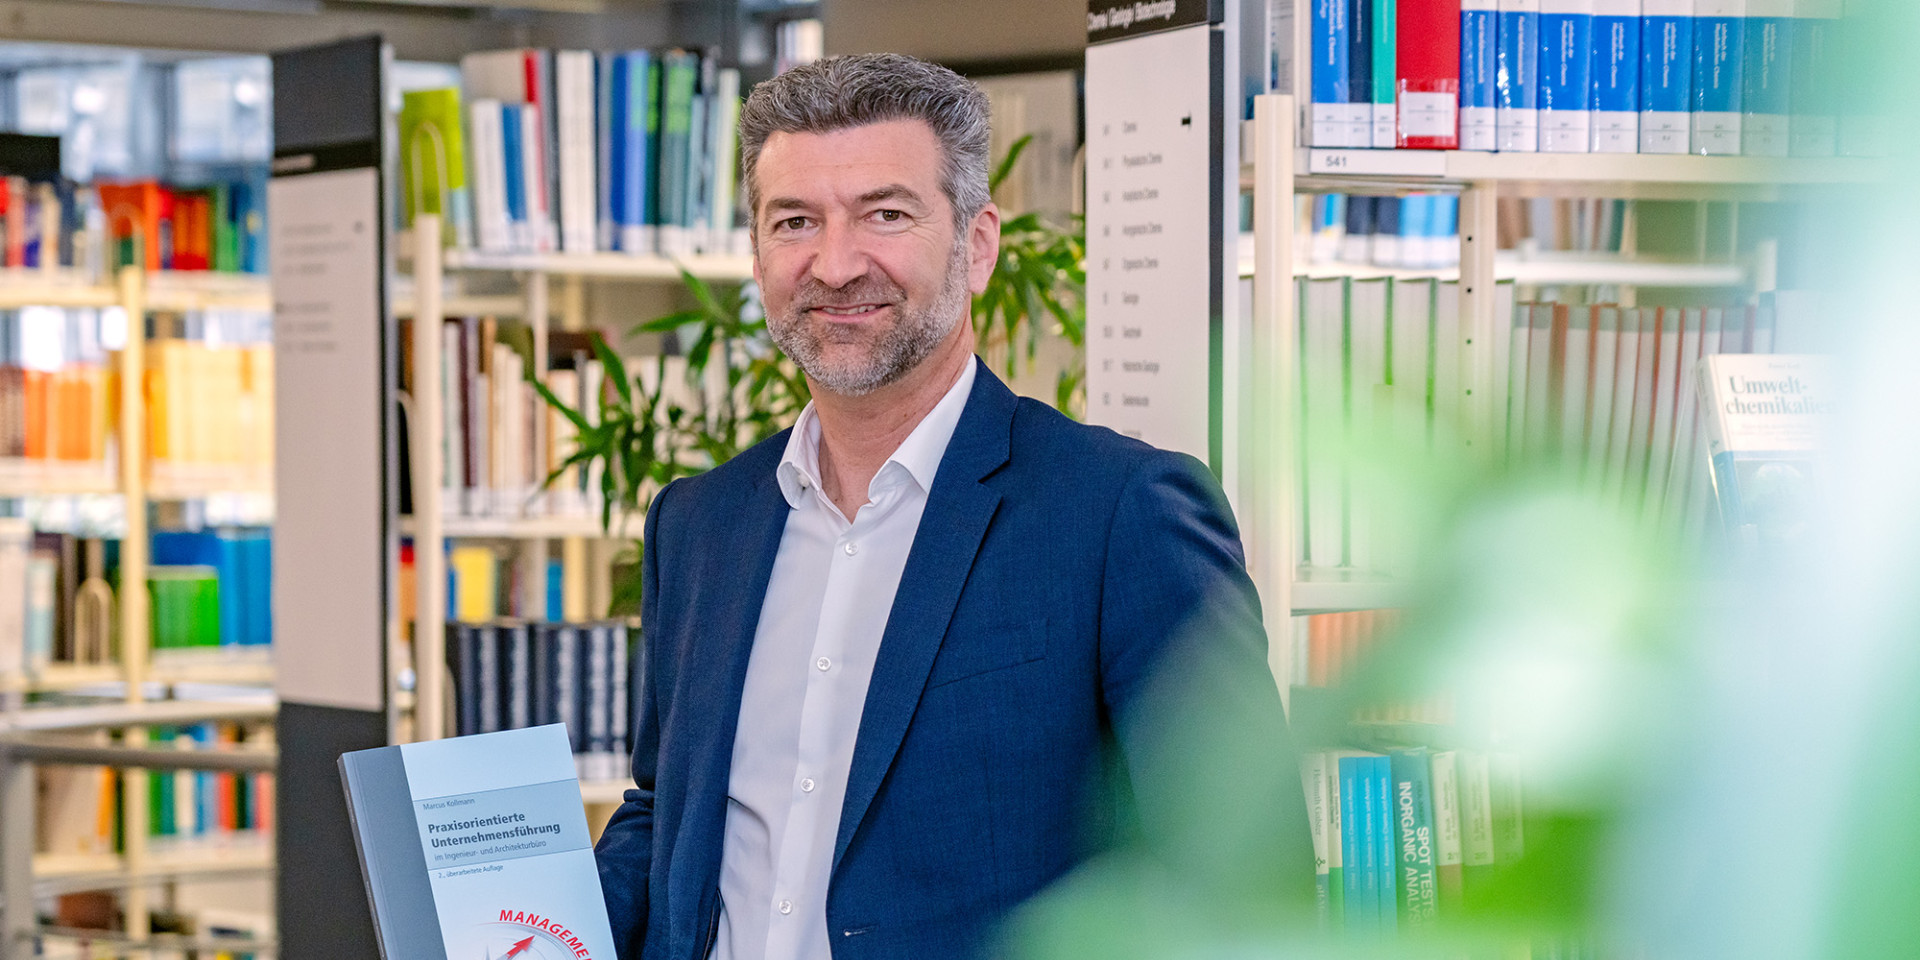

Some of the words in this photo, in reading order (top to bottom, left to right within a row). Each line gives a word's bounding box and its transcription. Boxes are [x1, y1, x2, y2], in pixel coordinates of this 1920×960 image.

[1326, 156, 1347, 167] 541
[1728, 375, 1808, 394] Umwelt-
[1312, 769, 1322, 804] Helmuth
[422, 802, 446, 810] Marcus
[446, 798, 475, 808] Kollmann
[428, 812, 526, 834] Praxisorientierte
[1314, 807, 1324, 836] Galster
[1398, 782, 1417, 862] INORGANIC
[431, 823, 560, 848] Unternehmensführung
[1416, 826, 1430, 866] SPOT
[434, 854, 444, 862] im
[445, 850, 478, 863] Ingenieur-
[480, 846, 494, 855] und
[494, 840, 547, 853] Architekturbüro
[446, 868, 482, 878] überarbeitete
[483, 864, 504, 874] Auflage
[1404, 867, 1422, 931] ANALYSI
[1420, 870, 1435, 918] TESTS
[499, 909, 592, 960] MANAGEME
